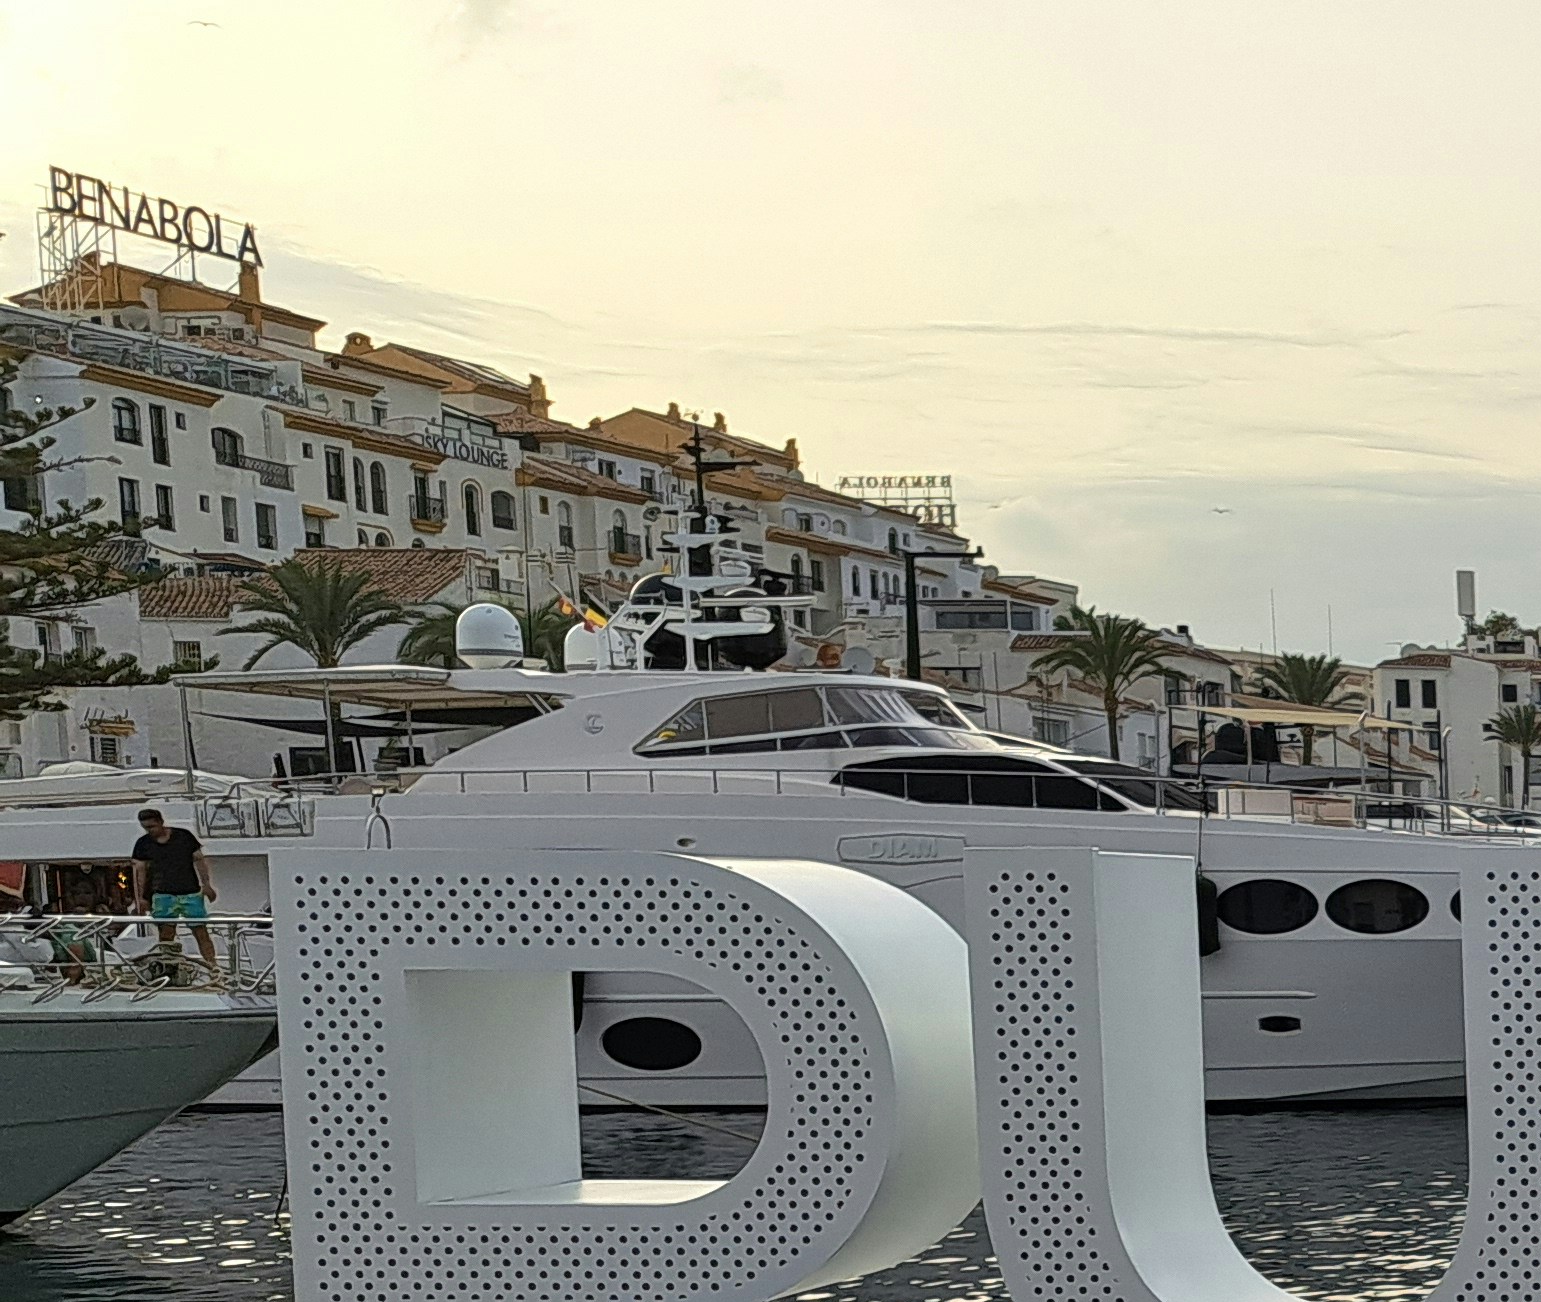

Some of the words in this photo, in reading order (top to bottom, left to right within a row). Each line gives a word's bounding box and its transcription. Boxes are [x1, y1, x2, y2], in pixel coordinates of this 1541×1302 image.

[49, 164, 263, 268] BENABOLA
[425, 434, 449, 454] SKY
[453, 440, 509, 470] LOUNGE
